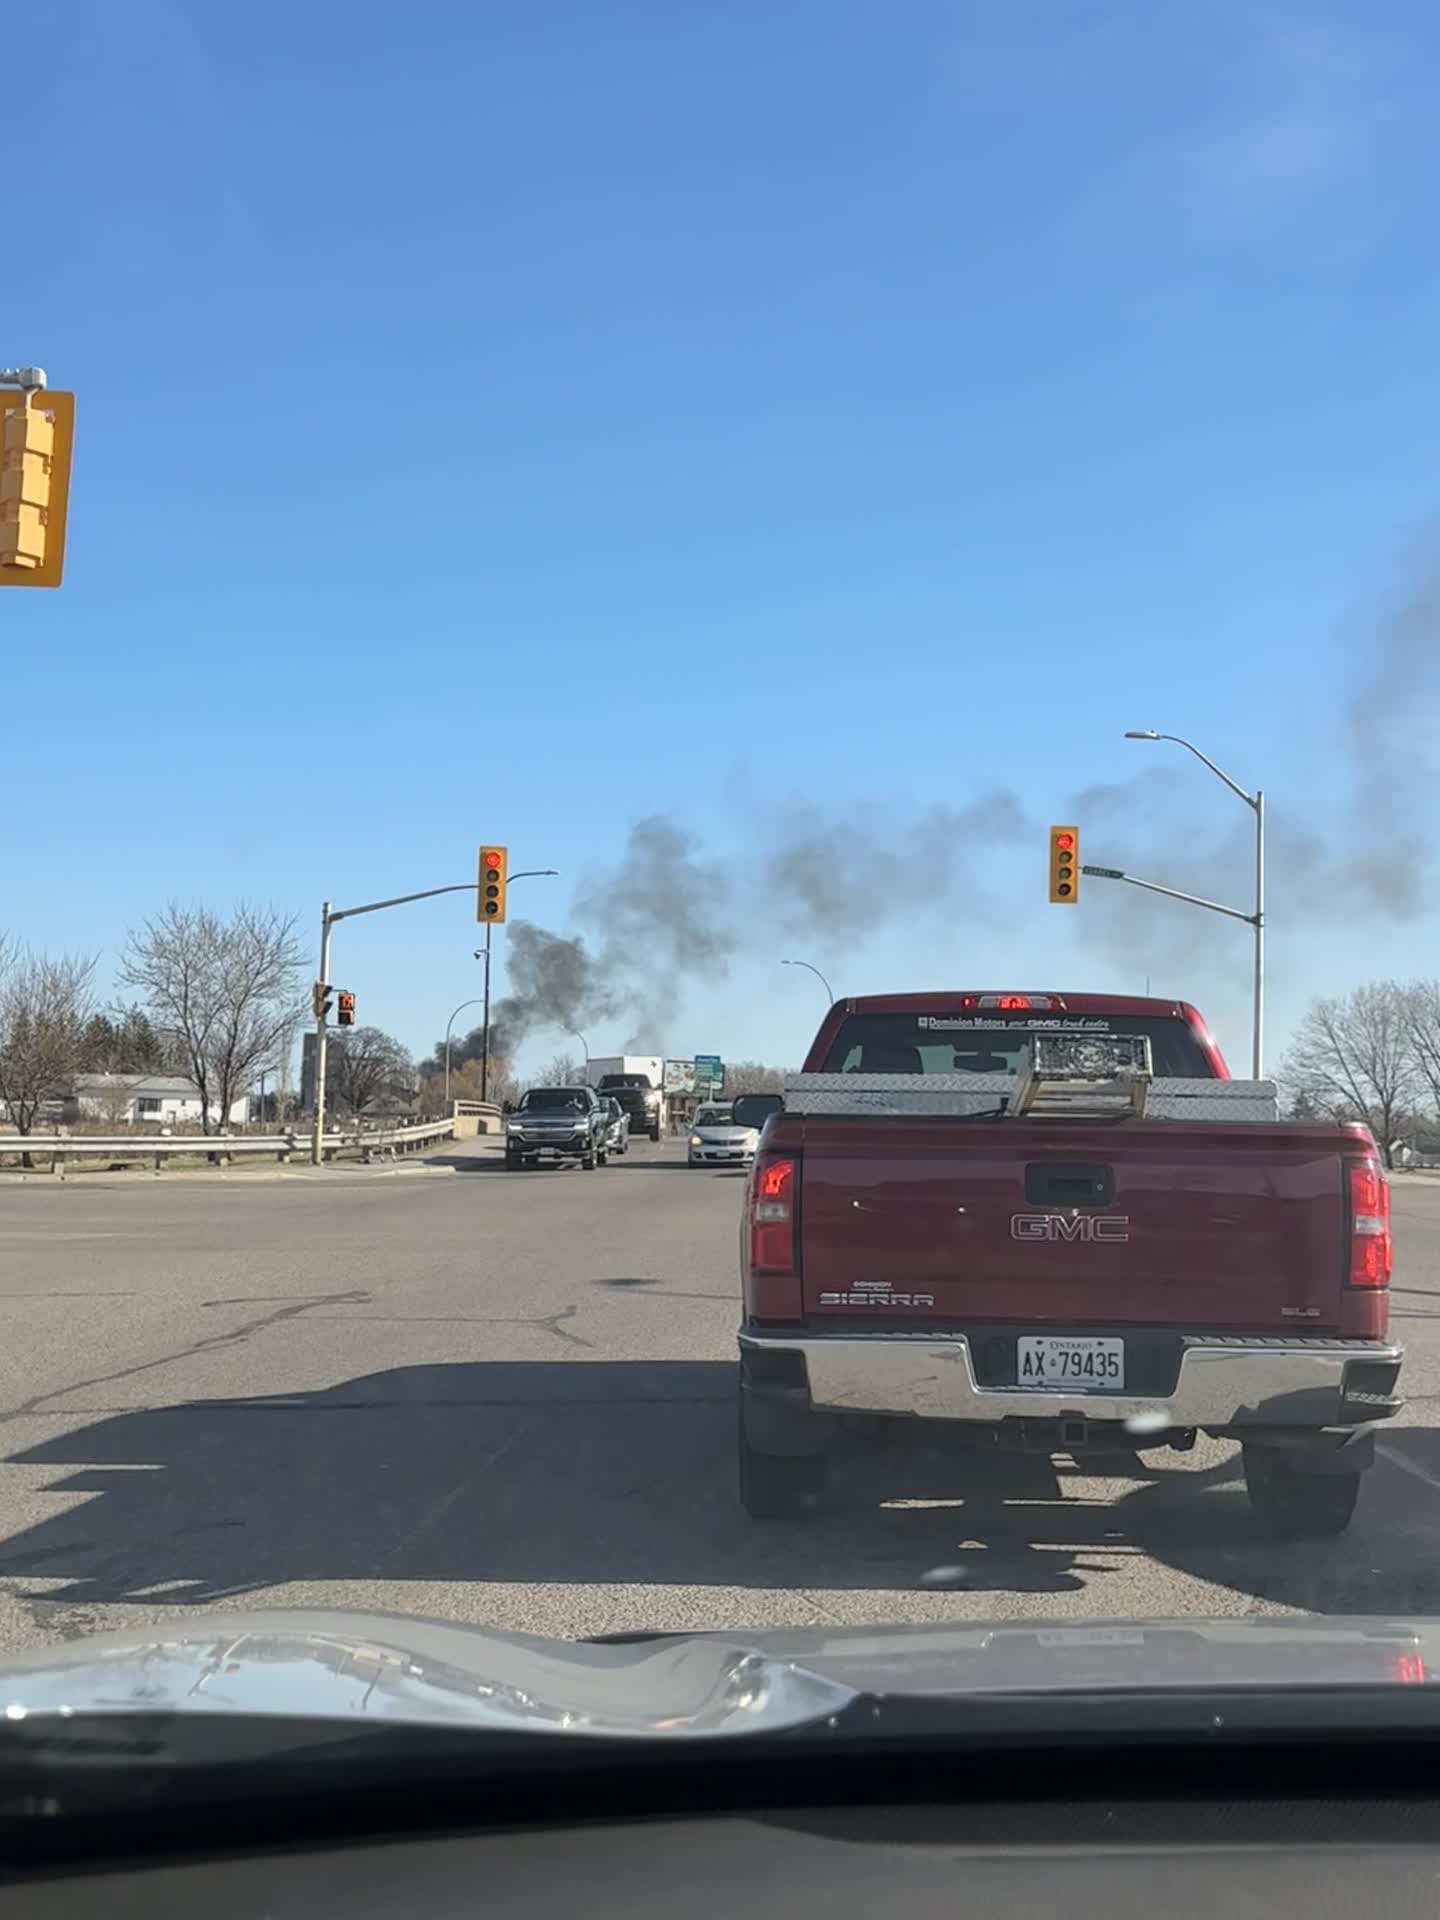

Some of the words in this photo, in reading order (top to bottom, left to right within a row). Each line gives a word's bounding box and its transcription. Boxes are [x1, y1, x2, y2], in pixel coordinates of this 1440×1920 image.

[929, 1017, 973, 1027] Dominion
[974, 1017, 1006, 1027] Motors
[1027, 1019, 1061, 1028] GMC
[1010, 1214, 1129, 1242] GMC
[820, 1293, 934, 1306] SIERRA
[1058, 1351, 1119, 1378] 79435
